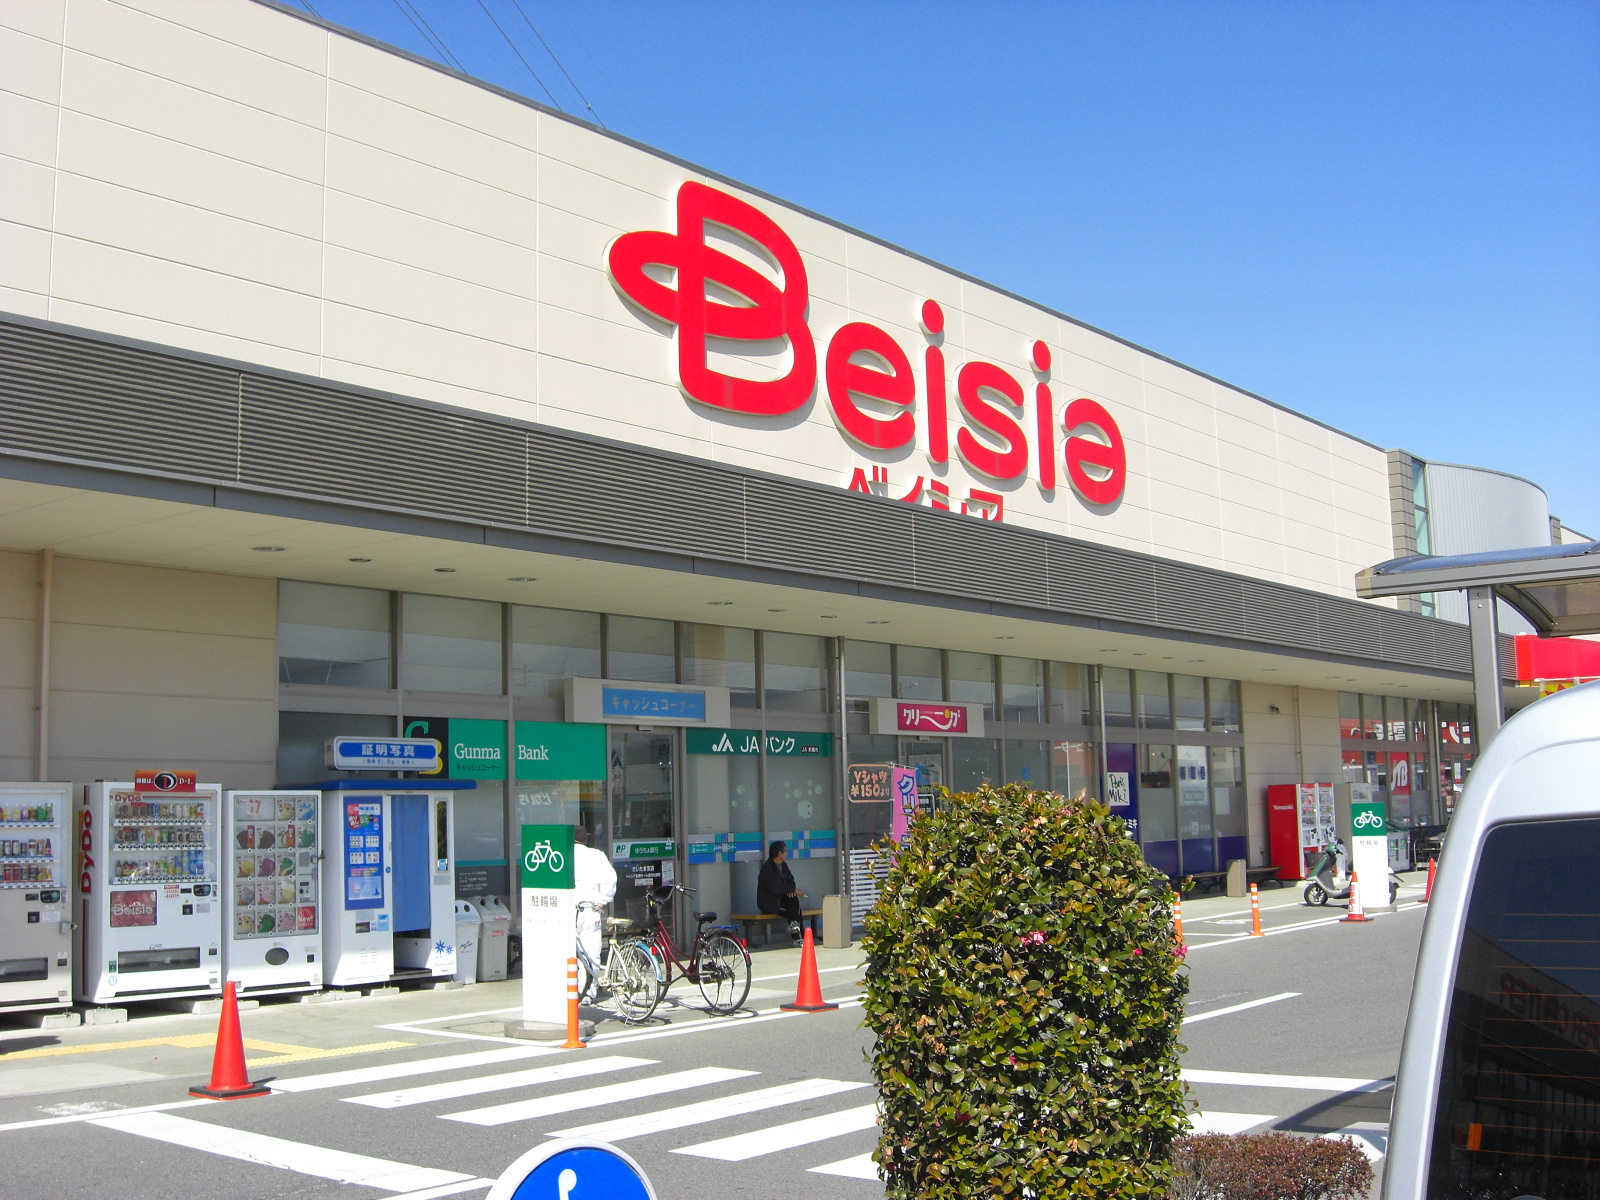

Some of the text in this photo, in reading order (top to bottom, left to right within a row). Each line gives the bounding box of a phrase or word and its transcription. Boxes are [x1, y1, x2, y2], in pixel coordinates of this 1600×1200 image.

[605, 181, 1126, 506] Beisia
[611, 696, 696, 712] キャッシュコーナー
[361, 744, 415, 757] 証明写真
[454, 743, 549, 760] Gunma Bank
[853, 770, 888, 784] Yシャツ
